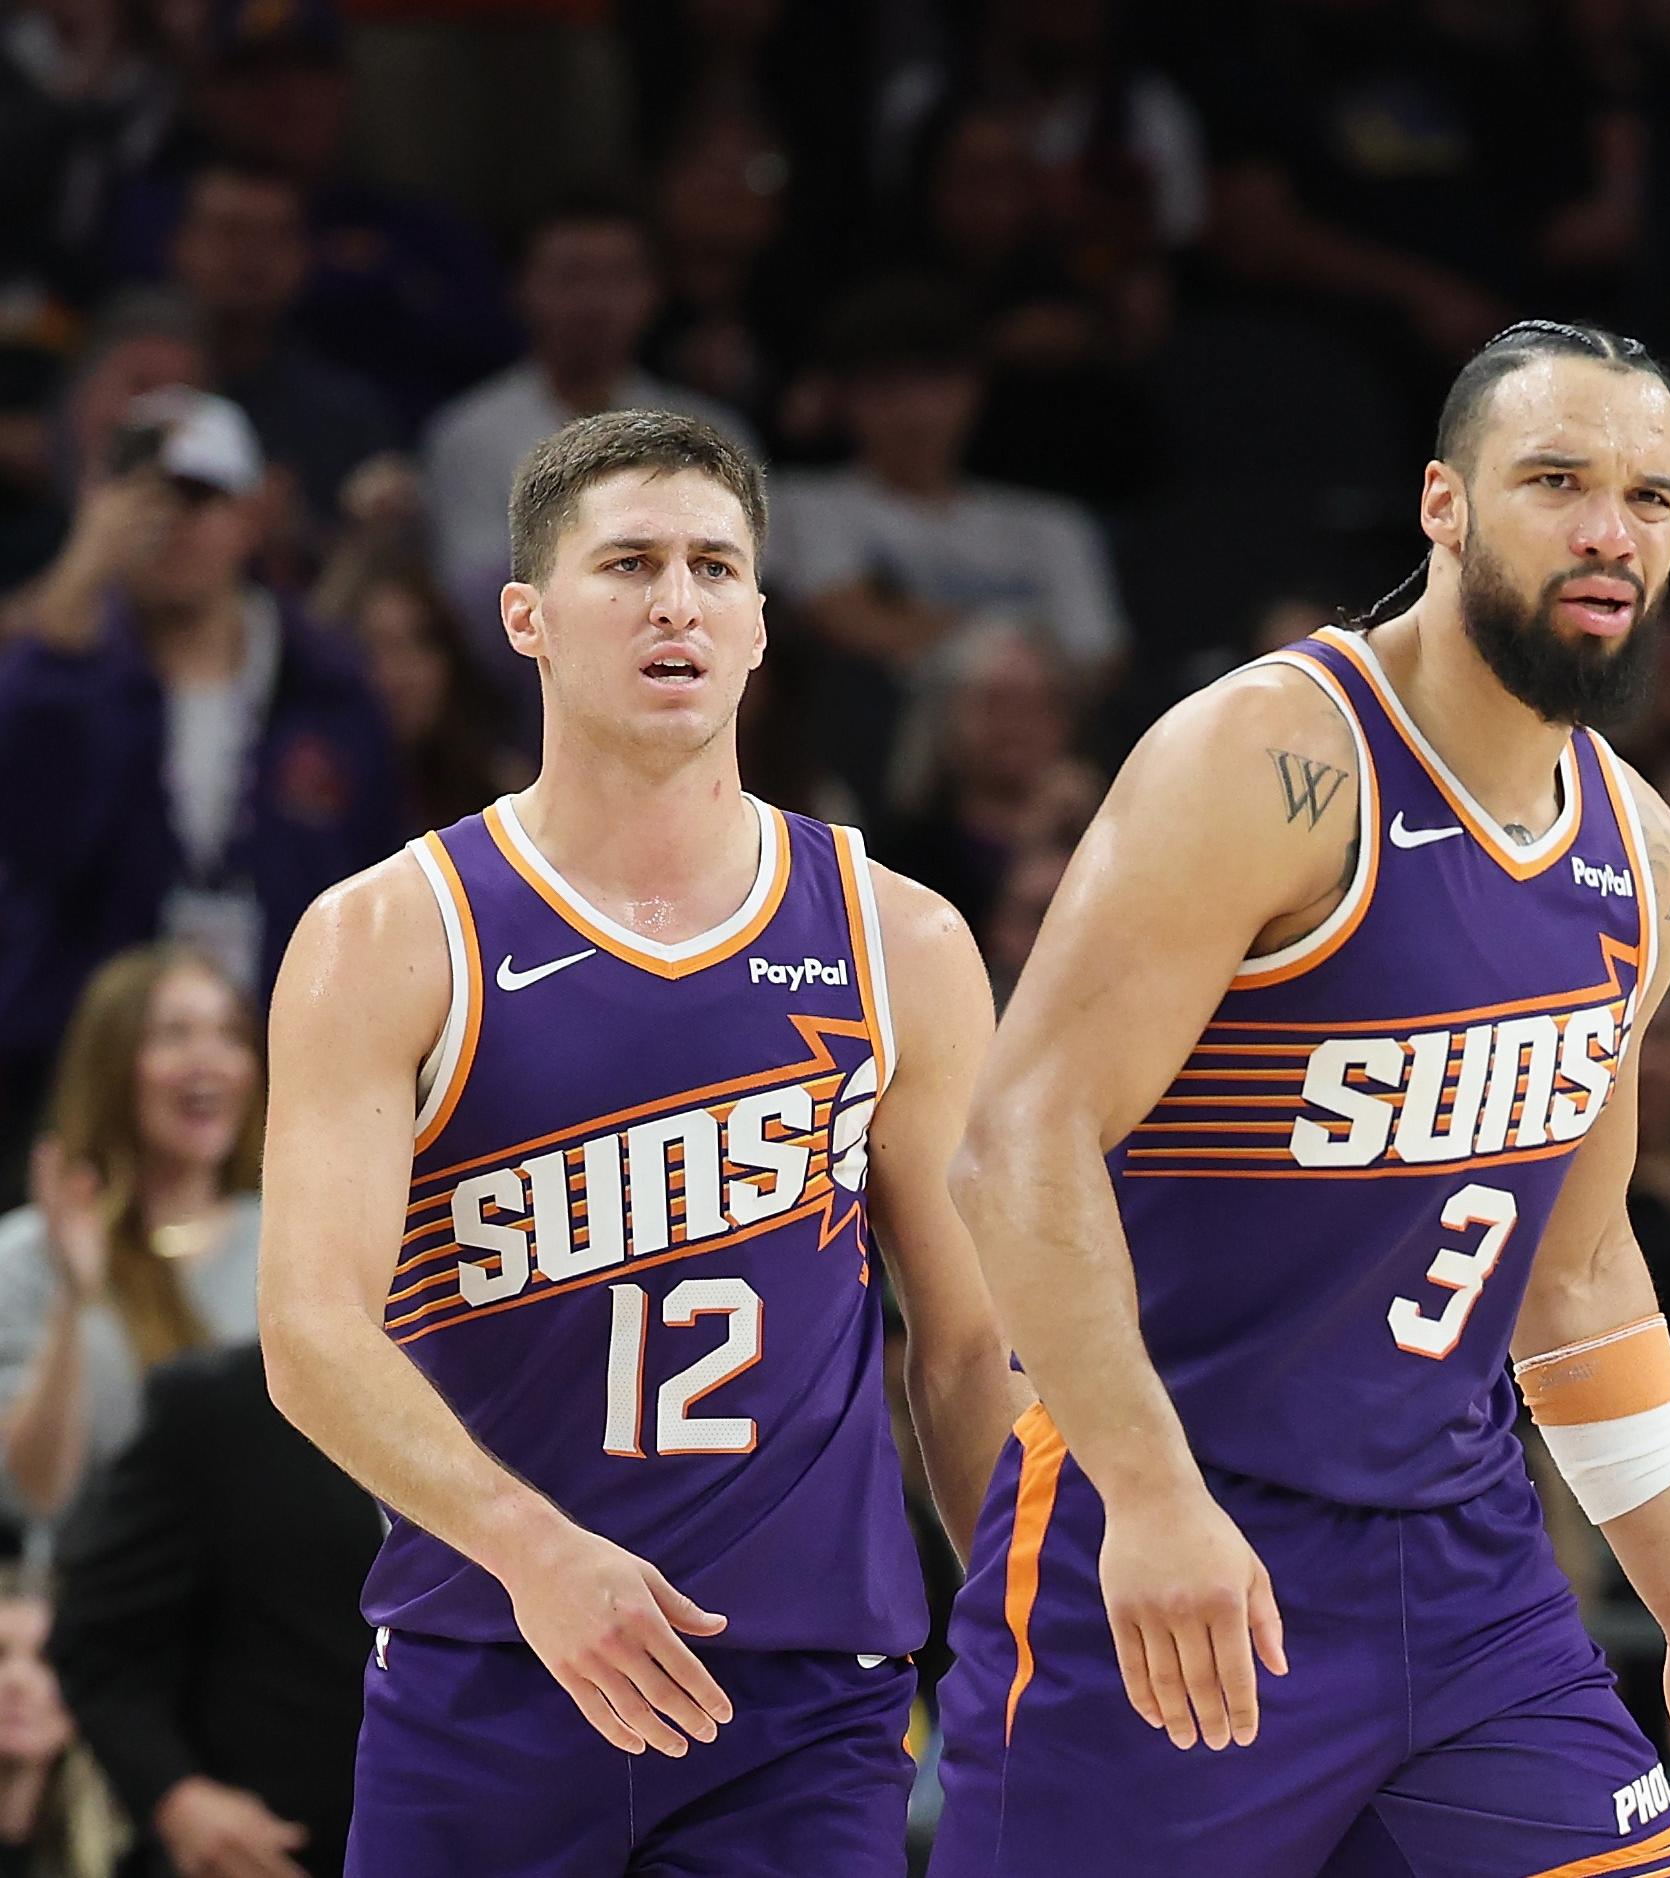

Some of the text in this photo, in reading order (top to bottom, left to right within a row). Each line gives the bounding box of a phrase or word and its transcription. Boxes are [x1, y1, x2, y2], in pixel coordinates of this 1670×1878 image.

[1265, 747, 1349, 833] W
[1571, 856, 1633, 897] PayPal
[748, 957, 849, 992] PayPal
[1290, 1005, 1615, 1167] SUNS
[451, 1084, 813, 1307] SUNS
[1387, 1183, 1518, 1361] 3
[602, 1277, 764, 1458] 12
